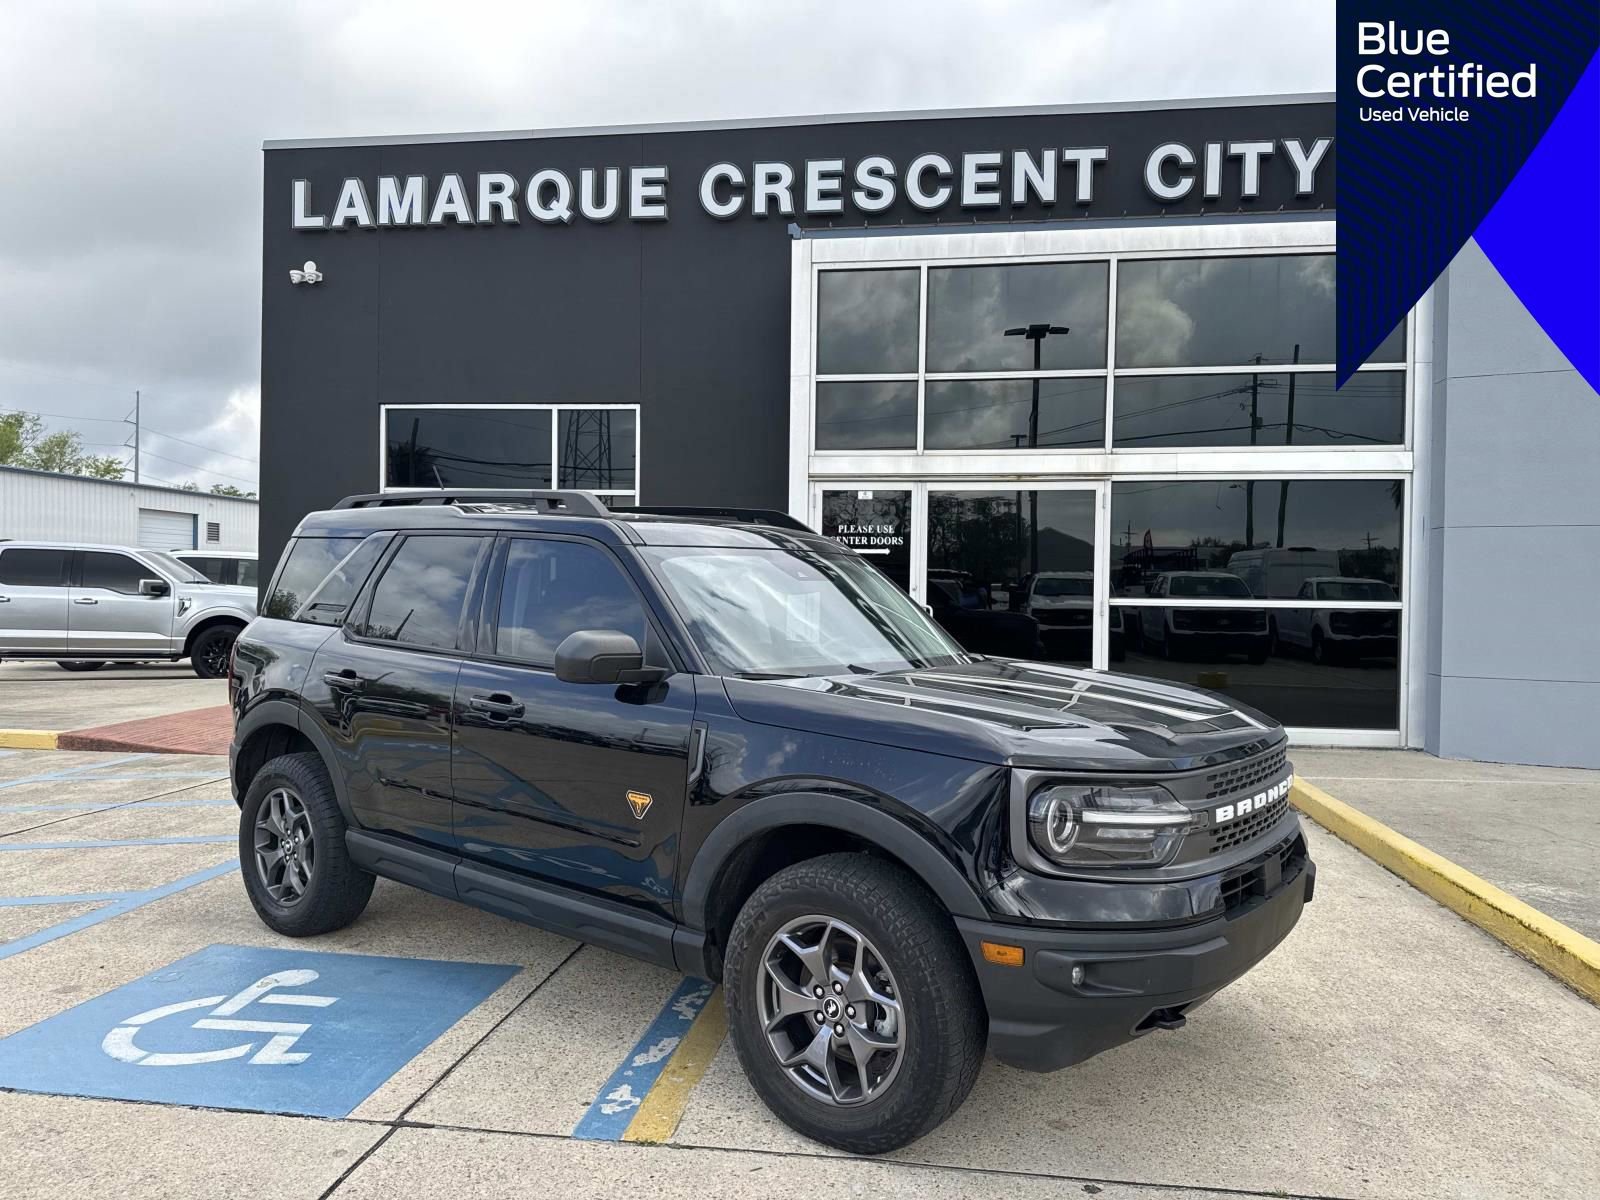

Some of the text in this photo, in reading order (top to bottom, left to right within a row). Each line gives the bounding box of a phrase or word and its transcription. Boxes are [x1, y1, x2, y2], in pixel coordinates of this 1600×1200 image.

[292, 136, 1334, 229] LAMARQUE CRESCENT CITY
[838, 524, 895, 534] PLEASE USE
[870, 536, 904, 545] DOORS
